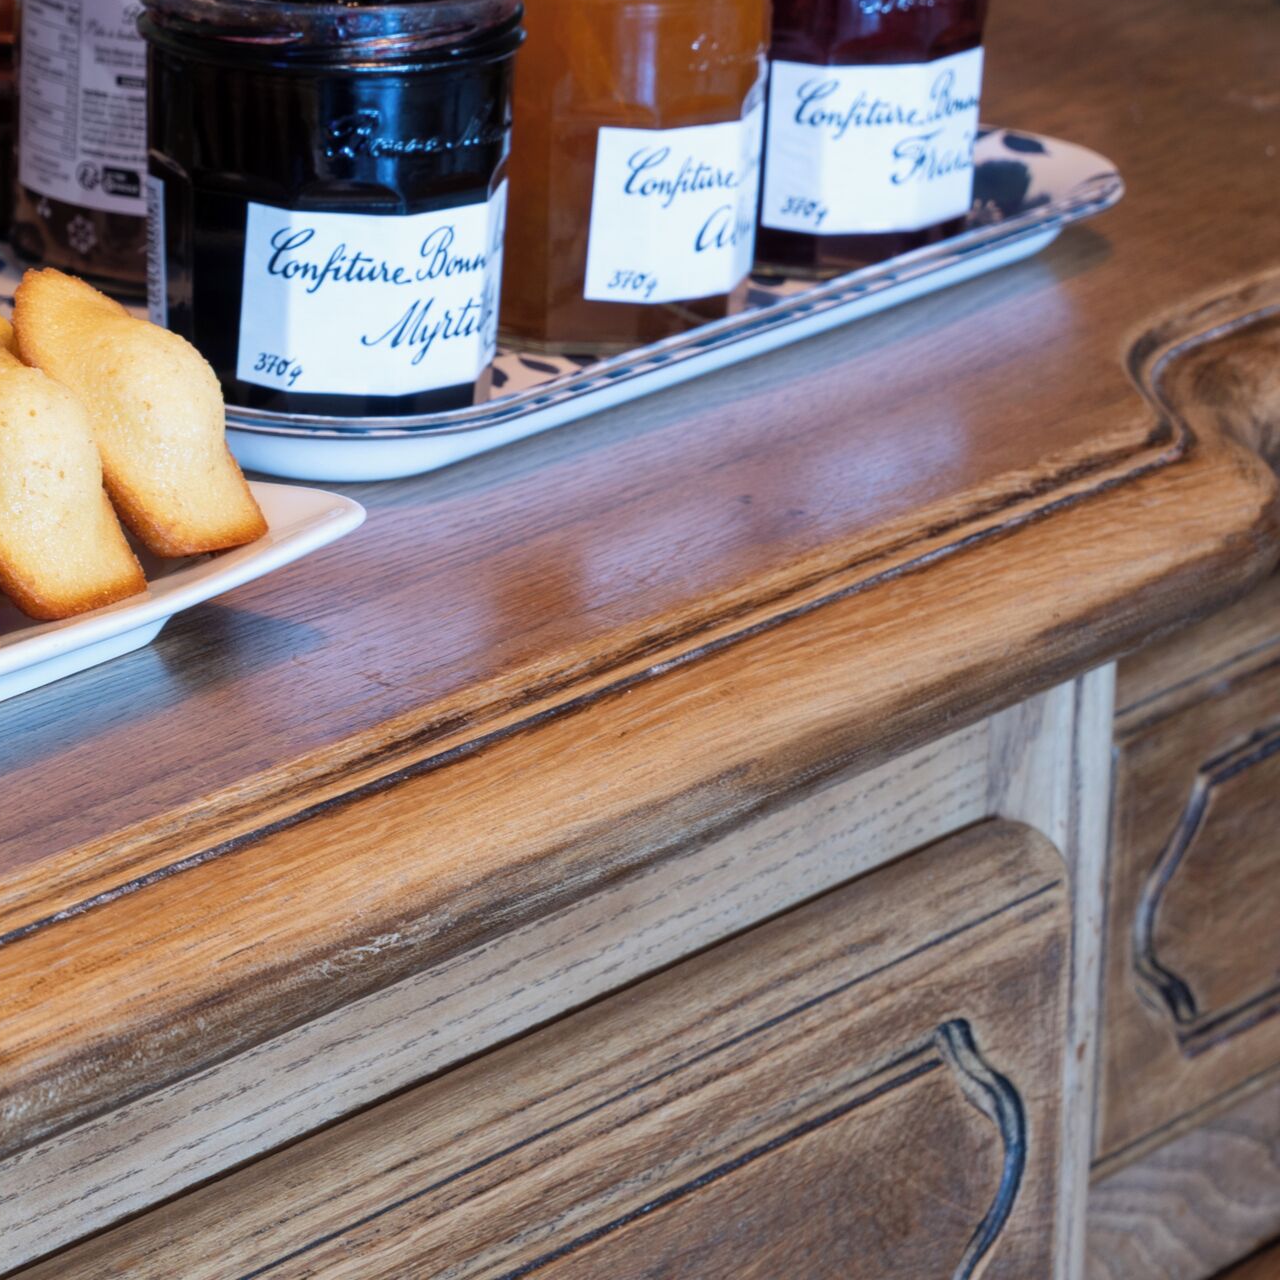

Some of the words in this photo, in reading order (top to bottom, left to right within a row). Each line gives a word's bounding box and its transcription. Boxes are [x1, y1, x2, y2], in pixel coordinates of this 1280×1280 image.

[794, 78, 926, 140] Confiture
[623, 146, 739, 209] Confiture
[267, 226, 413, 294] Confiture
[607, 269, 658, 298] 370g
[253, 352, 304, 387] 370g
